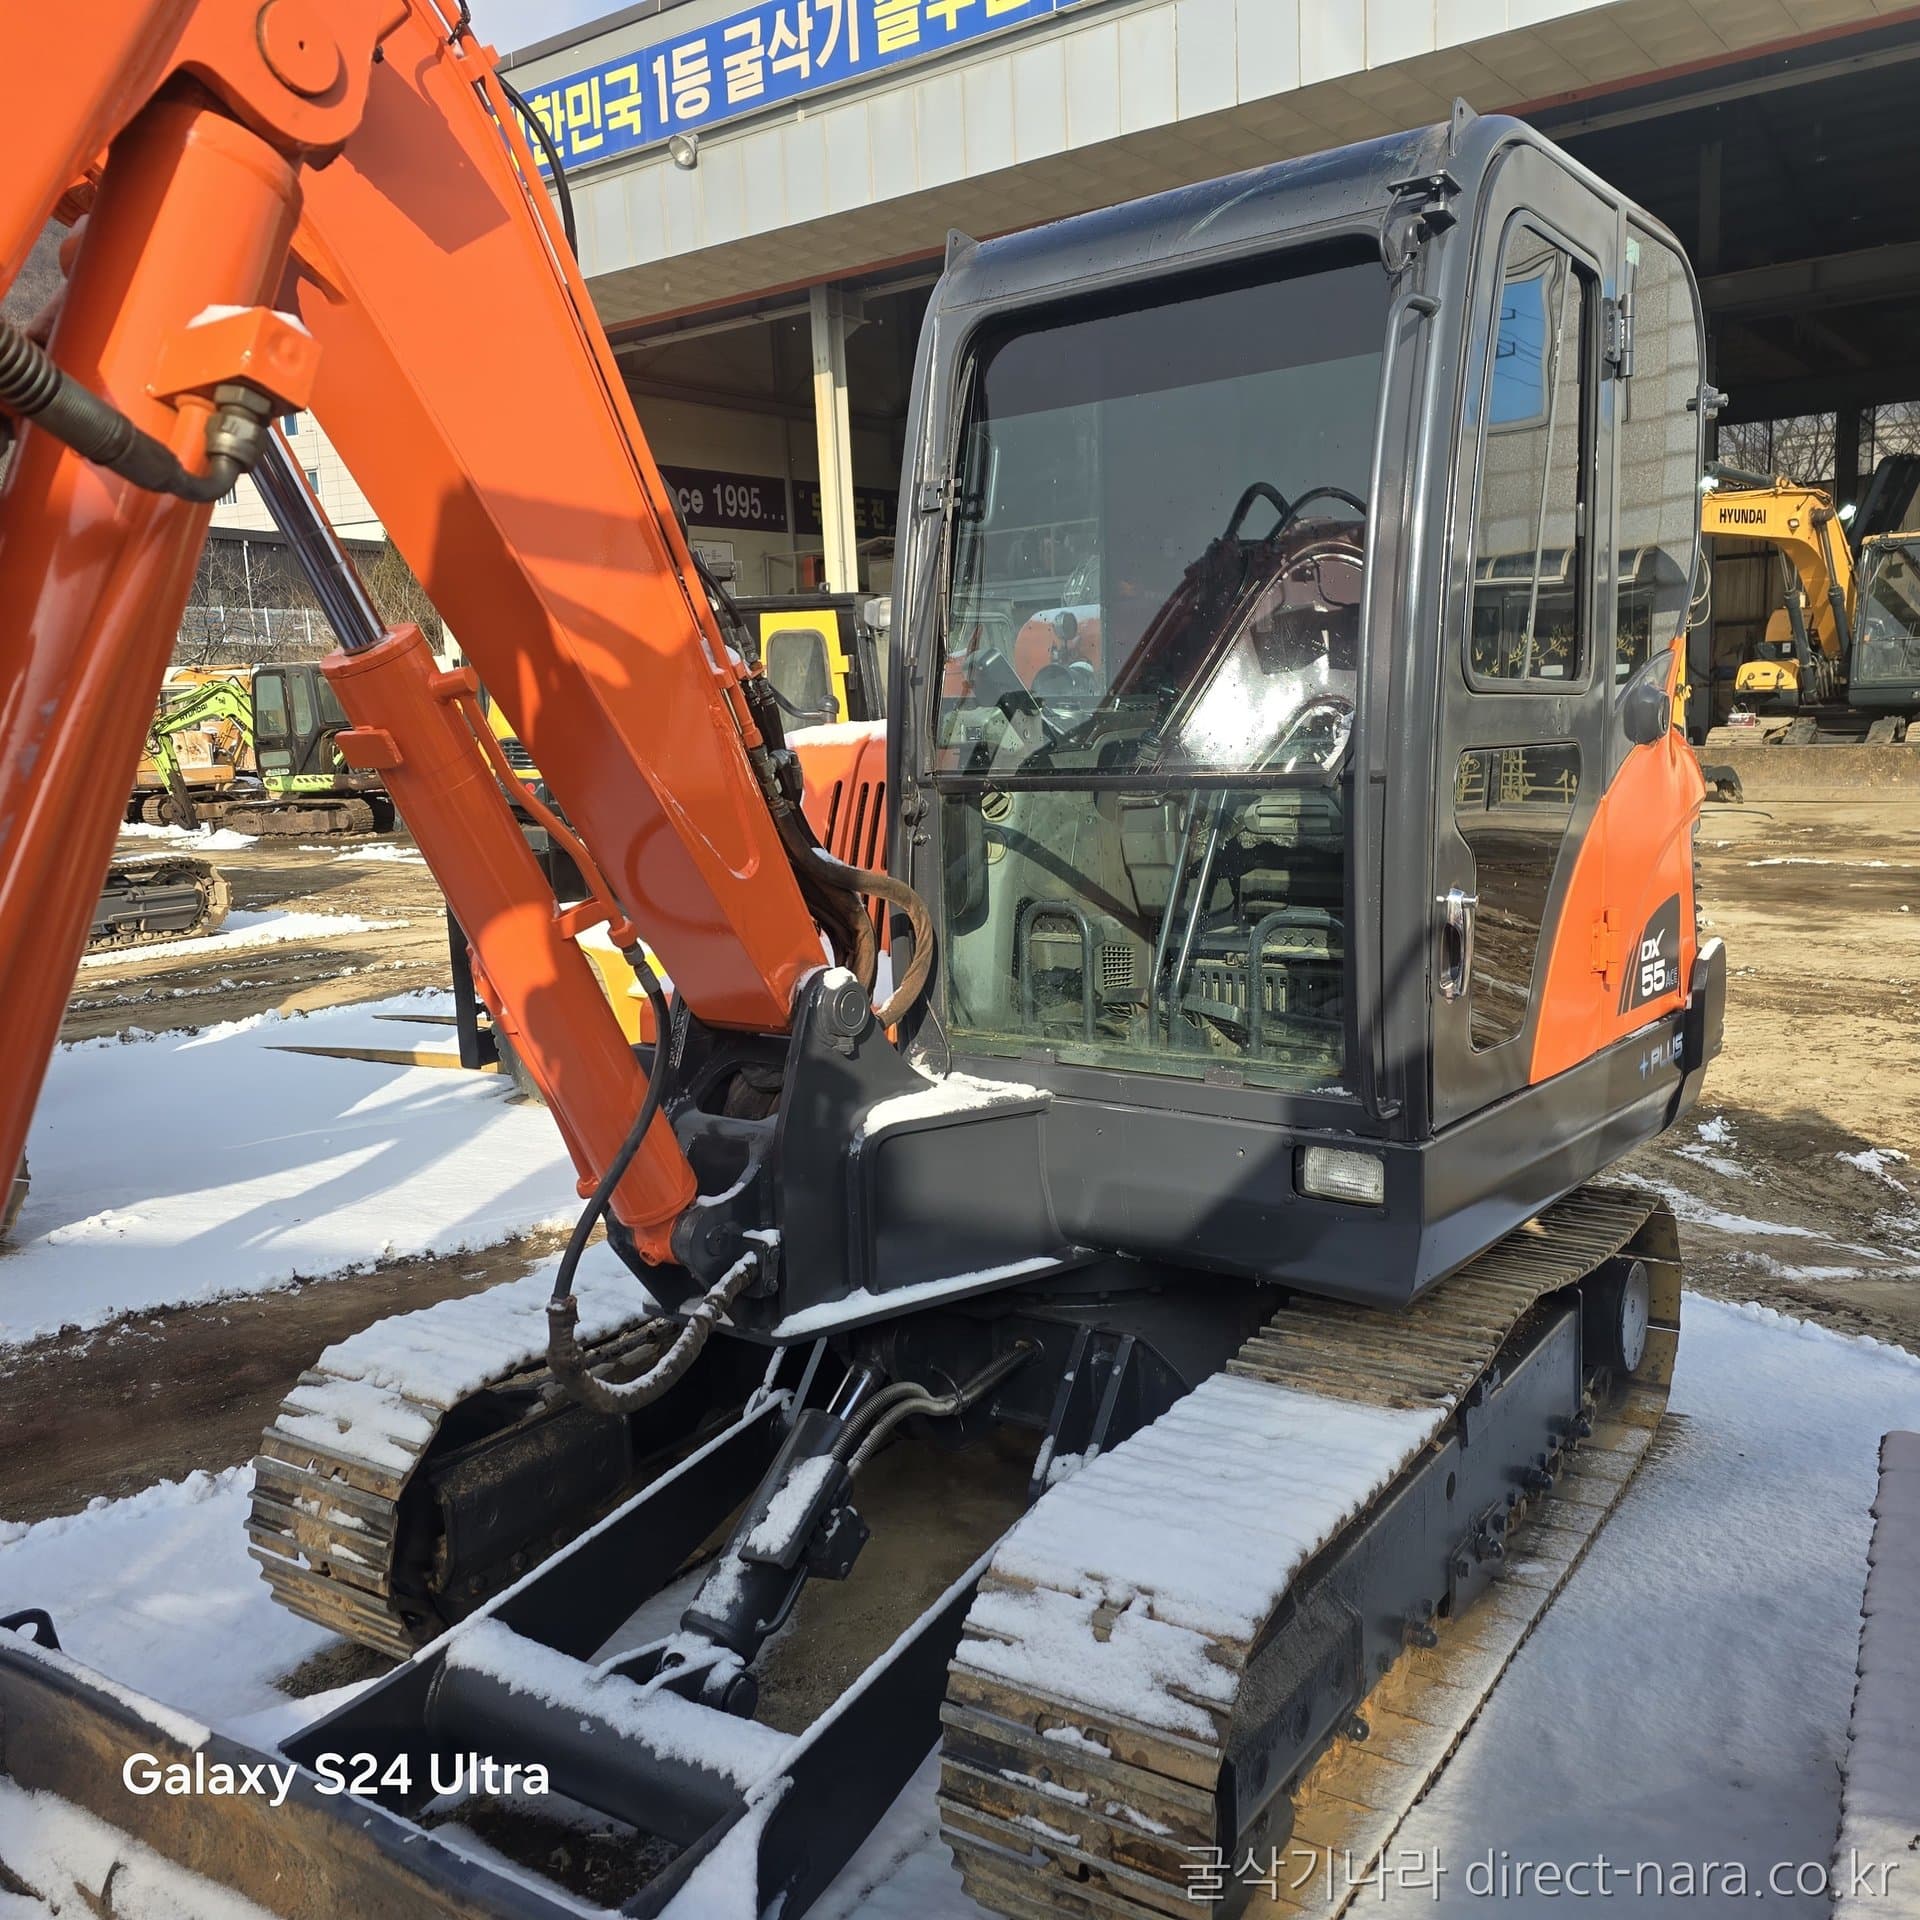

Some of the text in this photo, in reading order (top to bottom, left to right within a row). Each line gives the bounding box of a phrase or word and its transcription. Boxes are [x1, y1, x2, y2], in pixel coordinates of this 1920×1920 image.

[652, 39, 712, 124] 1등
[723, 0, 860, 105] 굴삭기
[1719, 508, 1767, 524] HYUNDAI
[1641, 928, 1665, 962] DX
[1641, 958, 1666, 997] 55
